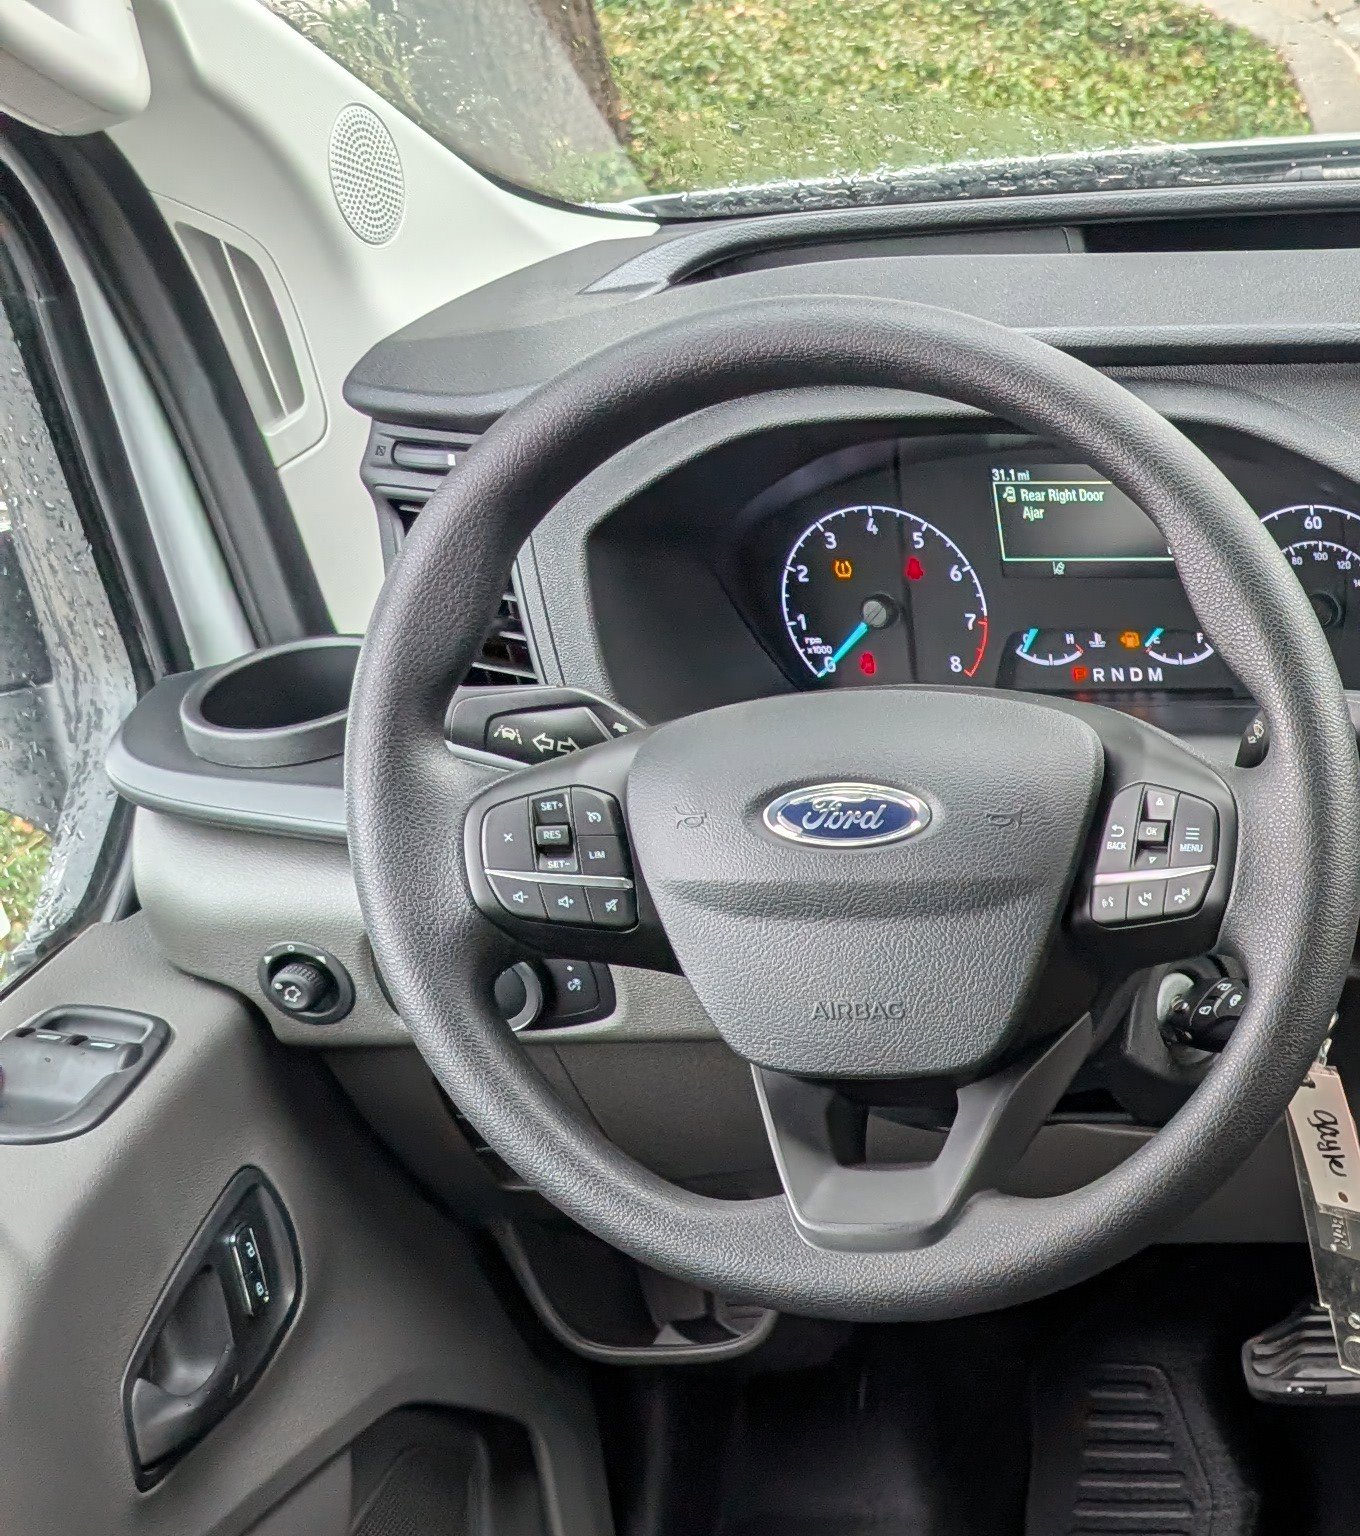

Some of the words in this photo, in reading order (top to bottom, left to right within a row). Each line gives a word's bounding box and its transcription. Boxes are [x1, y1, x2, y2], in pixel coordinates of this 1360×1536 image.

[992, 468, 1016, 481] 31.1
[1017, 470, 1030, 481] mi
[1020, 488, 1046, 502] Rear
[1049, 488, 1078, 505] Right
[1079, 488, 1105, 502] Door
[1022, 506, 1045, 522] Ajar
[866, 517, 879, 535] 4
[1304, 516, 1323, 530] 60
[824, 531, 838, 549] 3
[912, 531, 925, 549] 5
[1291, 556, 1303, 566] 80
[1313, 552, 1329, 561] 100
[1337, 560, 1352, 570] 120
[797, 565, 809, 583] 2
[949, 564, 963, 582] 6
[797, 613, 807, 631] 1
[964, 613, 976, 631] 7
[804, 637, 822, 646] rpm
[1065, 633, 1075, 644] H
[1196, 632, 1204, 644] F
[807, 645, 833, 655] x1000
[950, 655, 963, 673] 8
[1092, 668, 1106, 683] R
[1111, 668, 1125, 682] N
[1129, 668, 1143, 682] D
[1148, 668, 1164, 682] M
[540, 801, 564, 812] SET+
[802, 799, 887, 831] Ford
[543, 830, 562, 840] RES
[1145, 826, 1158, 836] OK
[1106, 841, 1127, 851] BACK
[1179, 843, 1204, 853] MENU
[588, 850, 606, 860] LIM
[811, 1000, 906, 1022] AIRBAG
